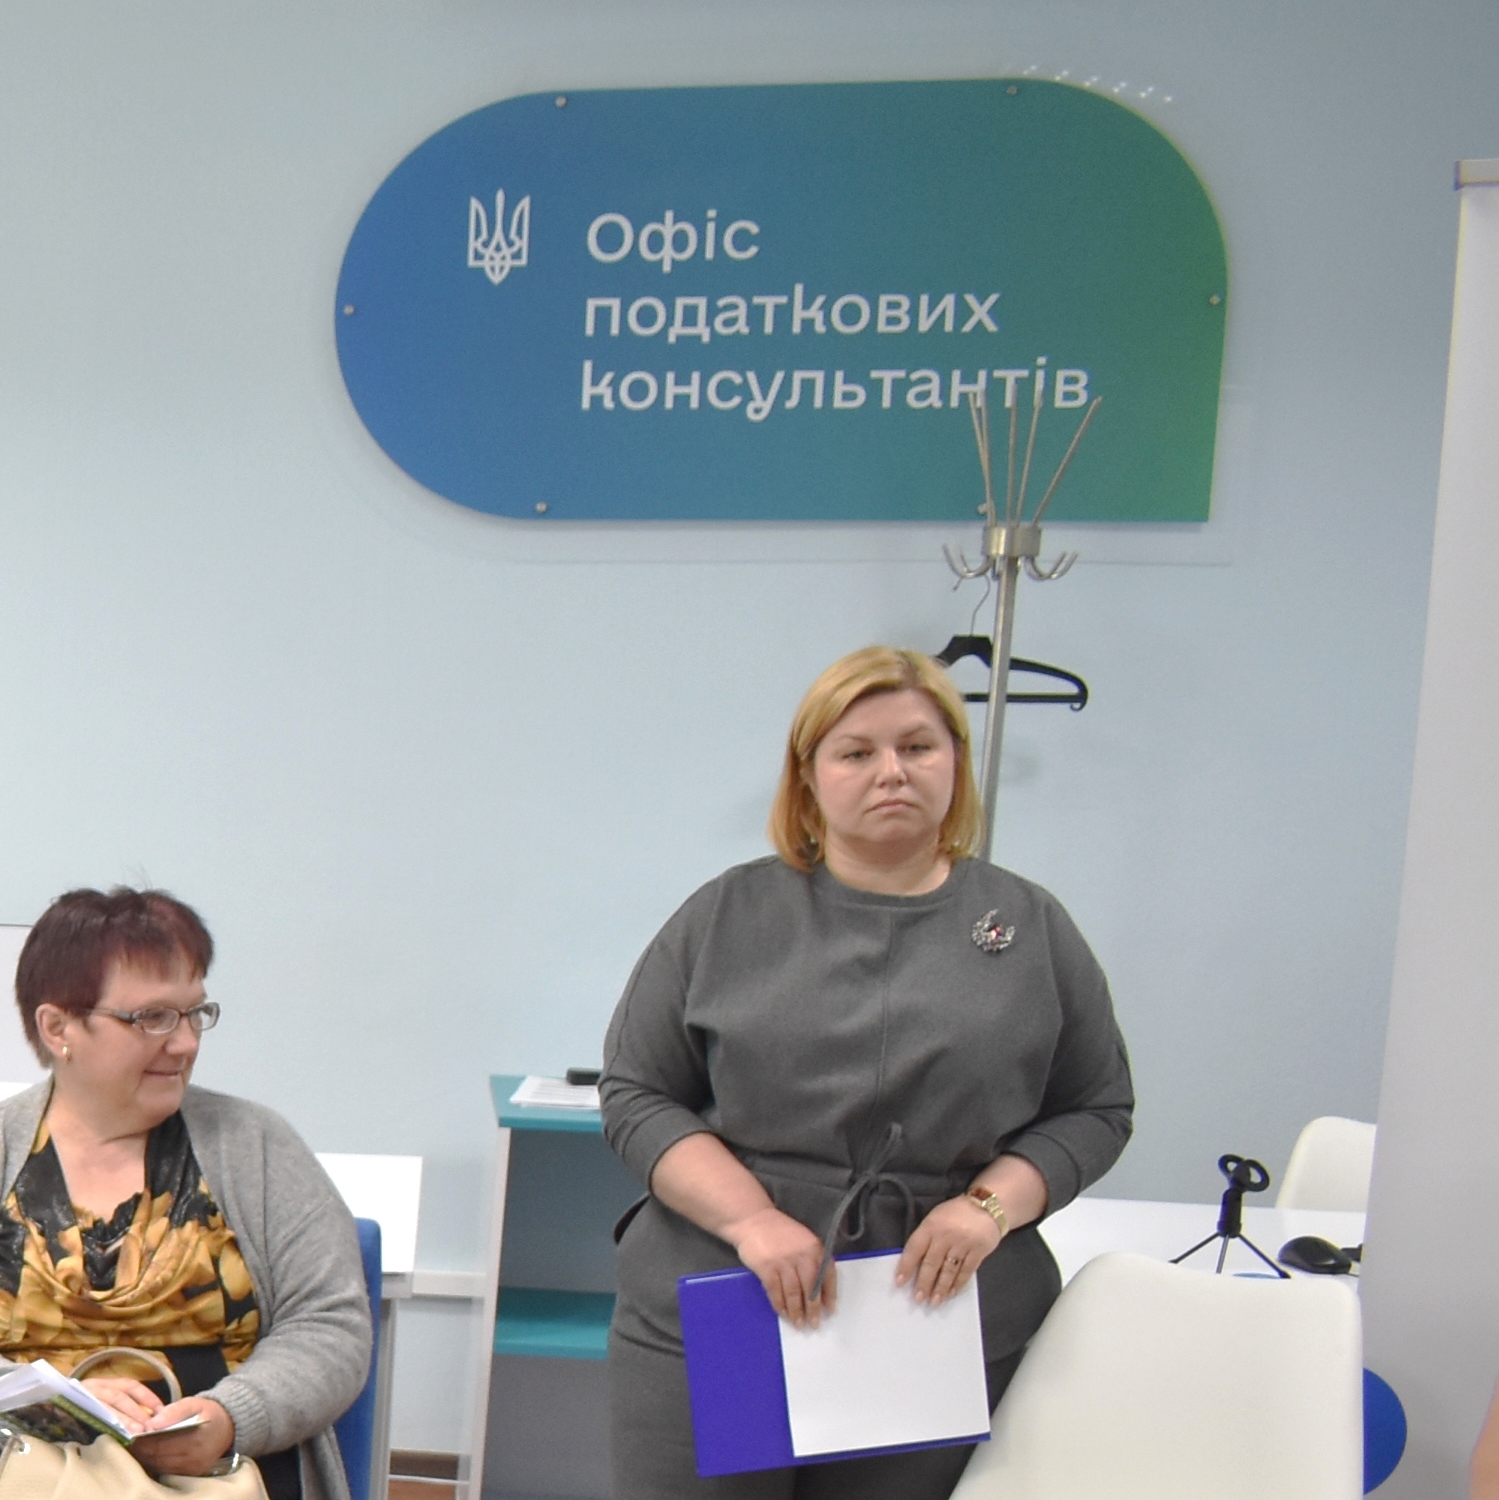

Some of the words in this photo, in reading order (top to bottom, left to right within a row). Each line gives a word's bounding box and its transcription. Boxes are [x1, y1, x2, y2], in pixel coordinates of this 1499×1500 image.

[586, 208, 760, 274] Офіс
[584, 282, 1001, 344] податкових
[580, 356, 1089, 422] консультантів
